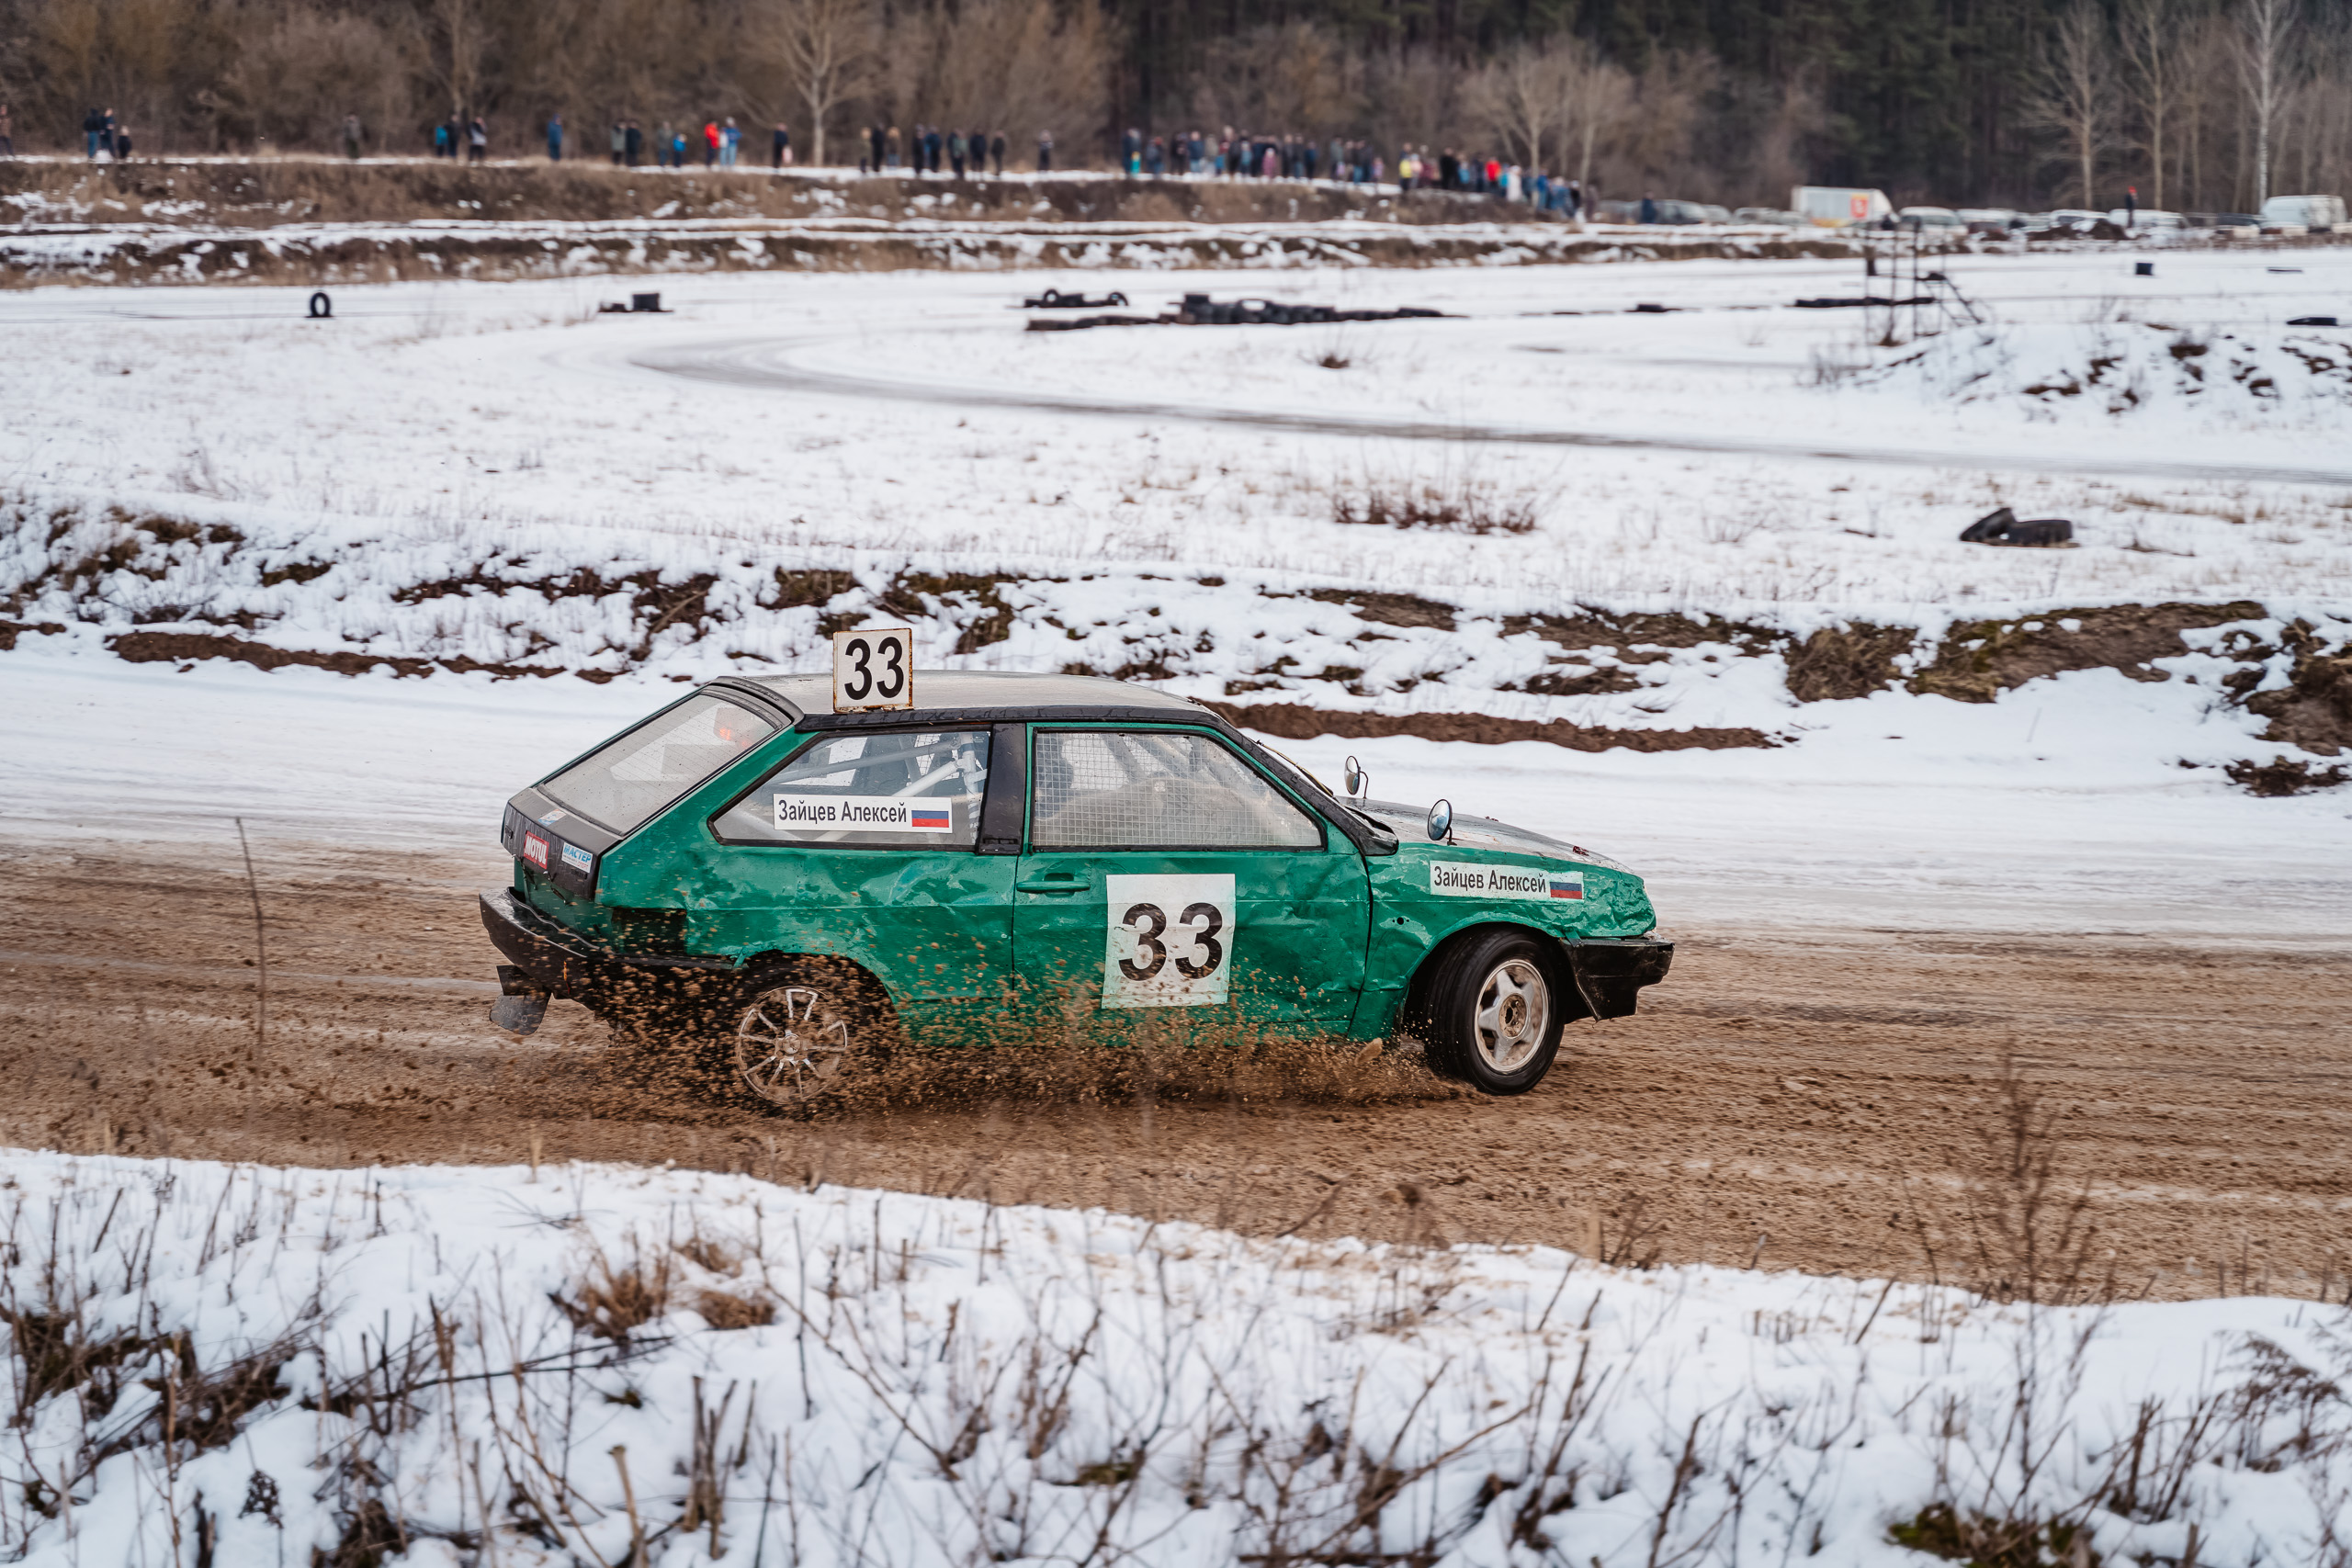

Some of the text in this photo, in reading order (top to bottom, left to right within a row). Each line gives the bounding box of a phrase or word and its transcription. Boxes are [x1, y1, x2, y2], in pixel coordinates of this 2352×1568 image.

[844, 637, 904, 700] 33
[778, 799, 907, 824] Зайцев Алексей
[525, 835, 547, 864] MOTUL
[563, 844, 591, 863] МАСТЕР
[1434, 866, 1546, 893] Зайцев Алексей
[1119, 903, 1223, 981] 33
